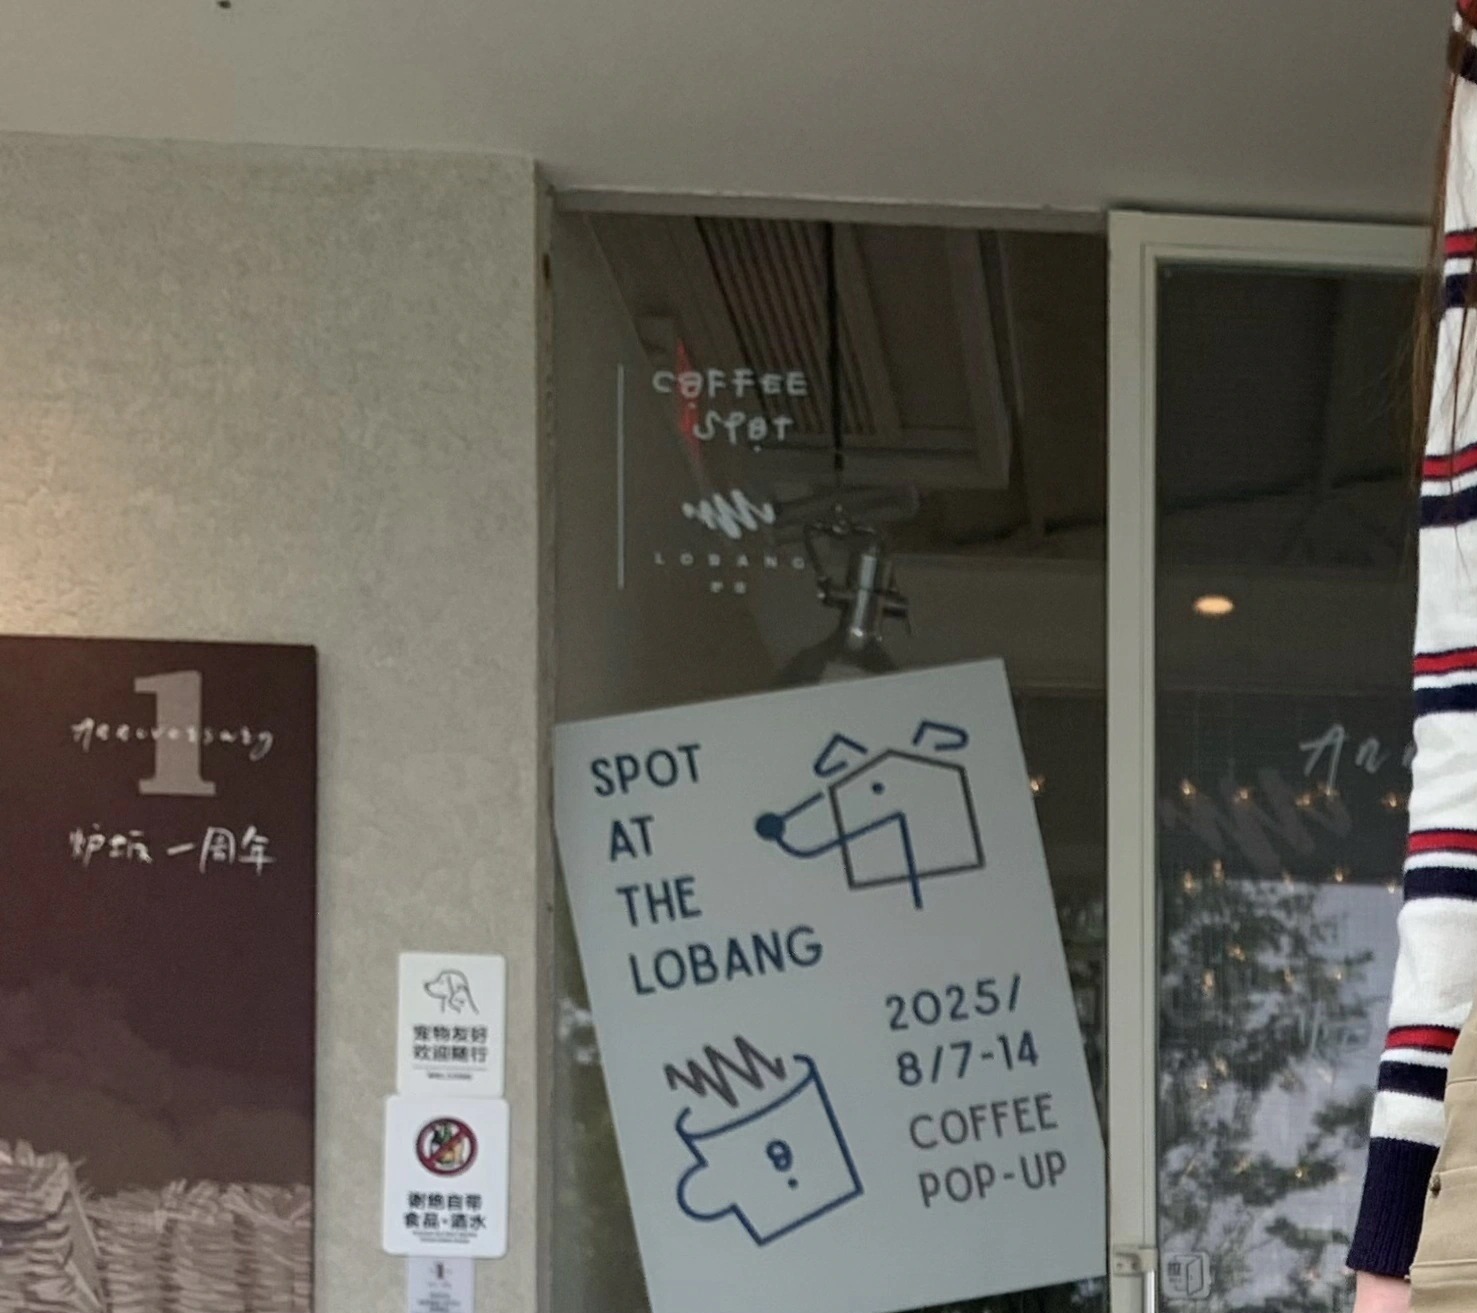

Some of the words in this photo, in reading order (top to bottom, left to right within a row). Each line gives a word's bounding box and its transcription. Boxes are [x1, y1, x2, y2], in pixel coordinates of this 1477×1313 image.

[134, 670, 216, 796] 1
[591, 743, 702, 797] SPOT
[608, 815, 656, 861] AT
[616, 876, 702, 928] THE
[629, 925, 823, 996] LOBANG
[884, 973, 1022, 1031] 2025/
[897, 1029, 1039, 1088] 8/7-14
[908, 1092, 1058, 1151] COFFEE
[918, 1150, 1067, 1207] POP-UP
